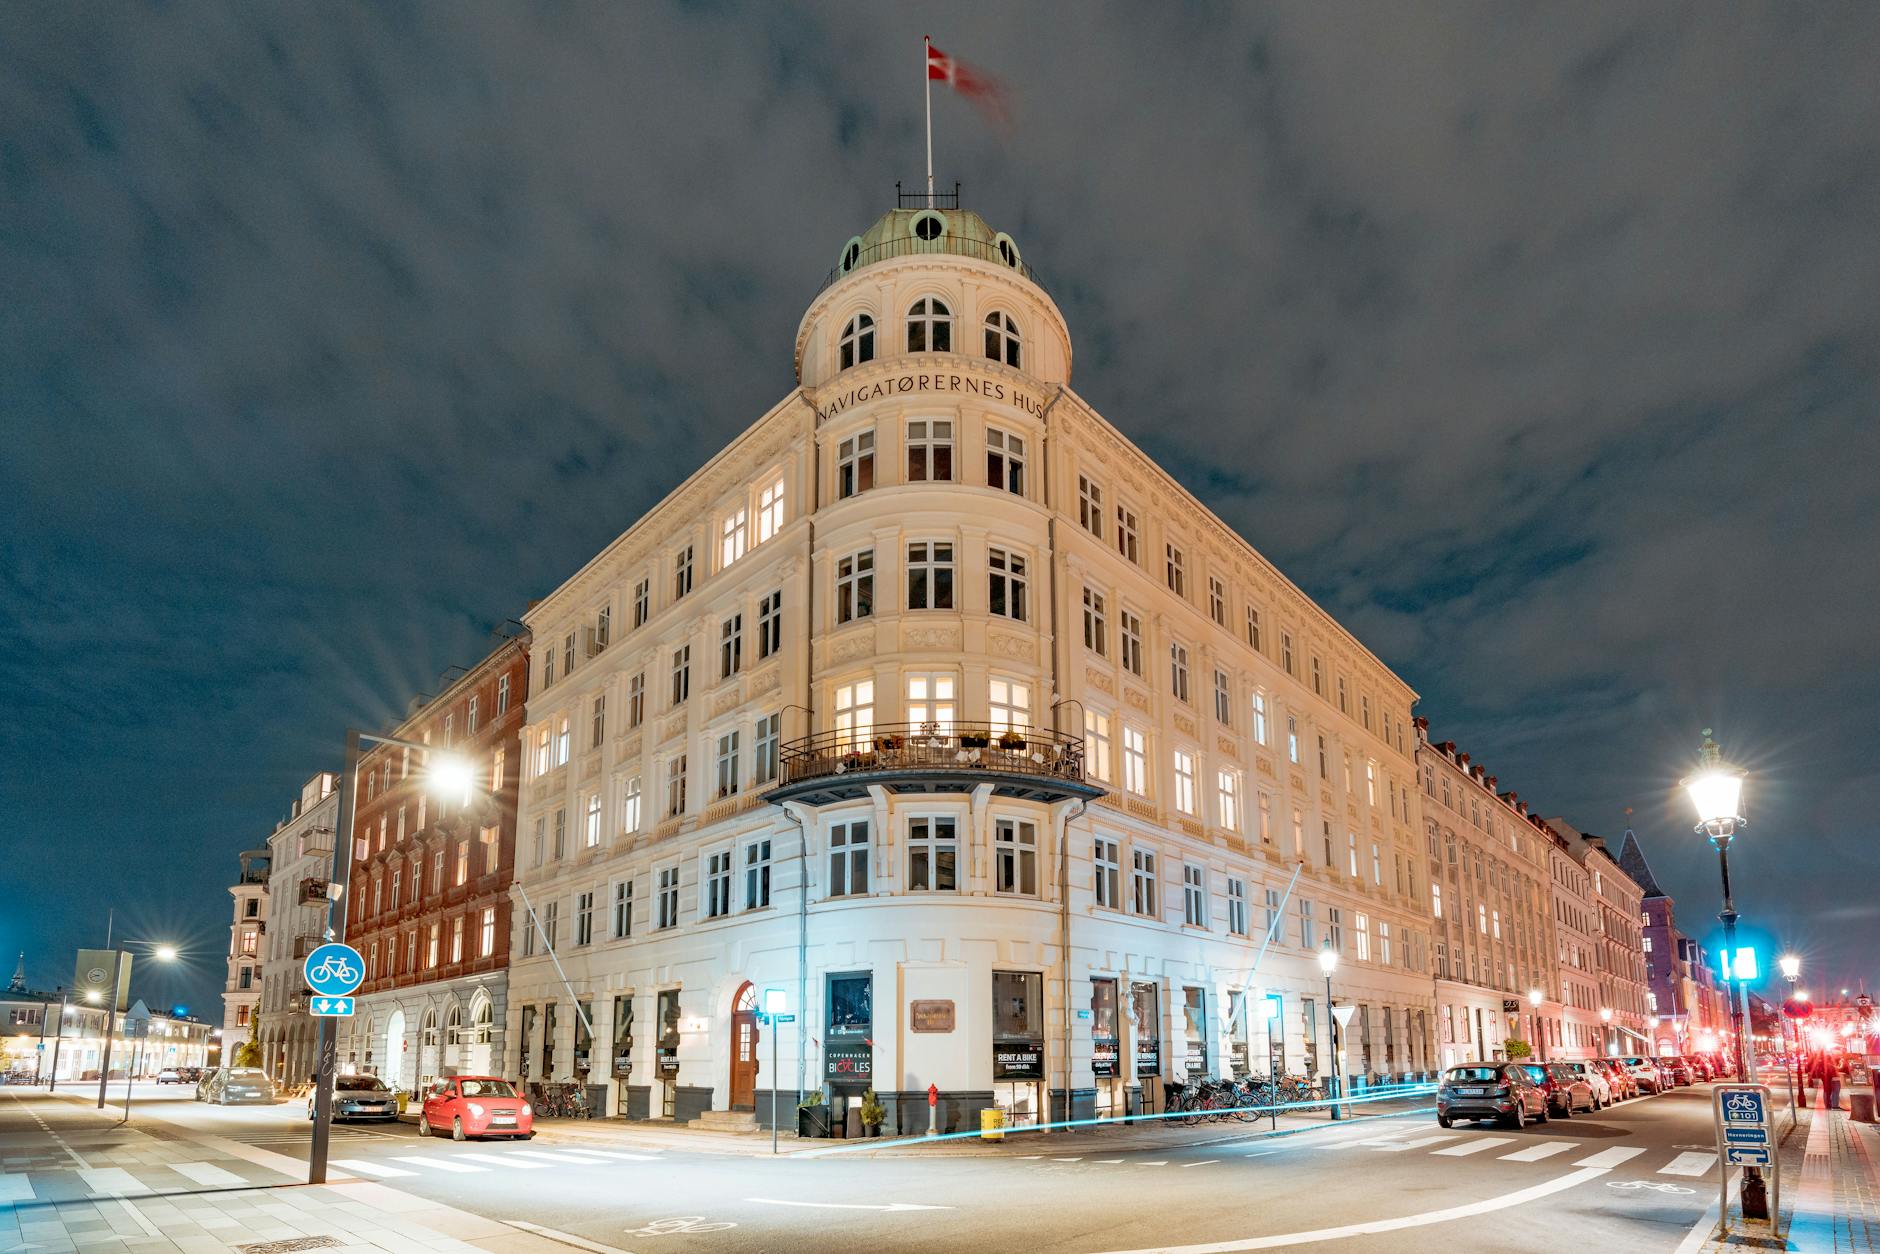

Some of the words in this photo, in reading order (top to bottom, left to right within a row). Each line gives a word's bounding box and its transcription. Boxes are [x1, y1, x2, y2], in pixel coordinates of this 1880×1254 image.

[818, 374, 1004, 421] NAVIGATØRERNES
[1013, 390, 1044, 420] HUS
[998, 1053, 1016, 1062] RENT
[1016, 1053, 1022, 1062] A
[1022, 1053, 1037, 1062] BIKE
[828, 1061, 871, 1073] BICYCLES
